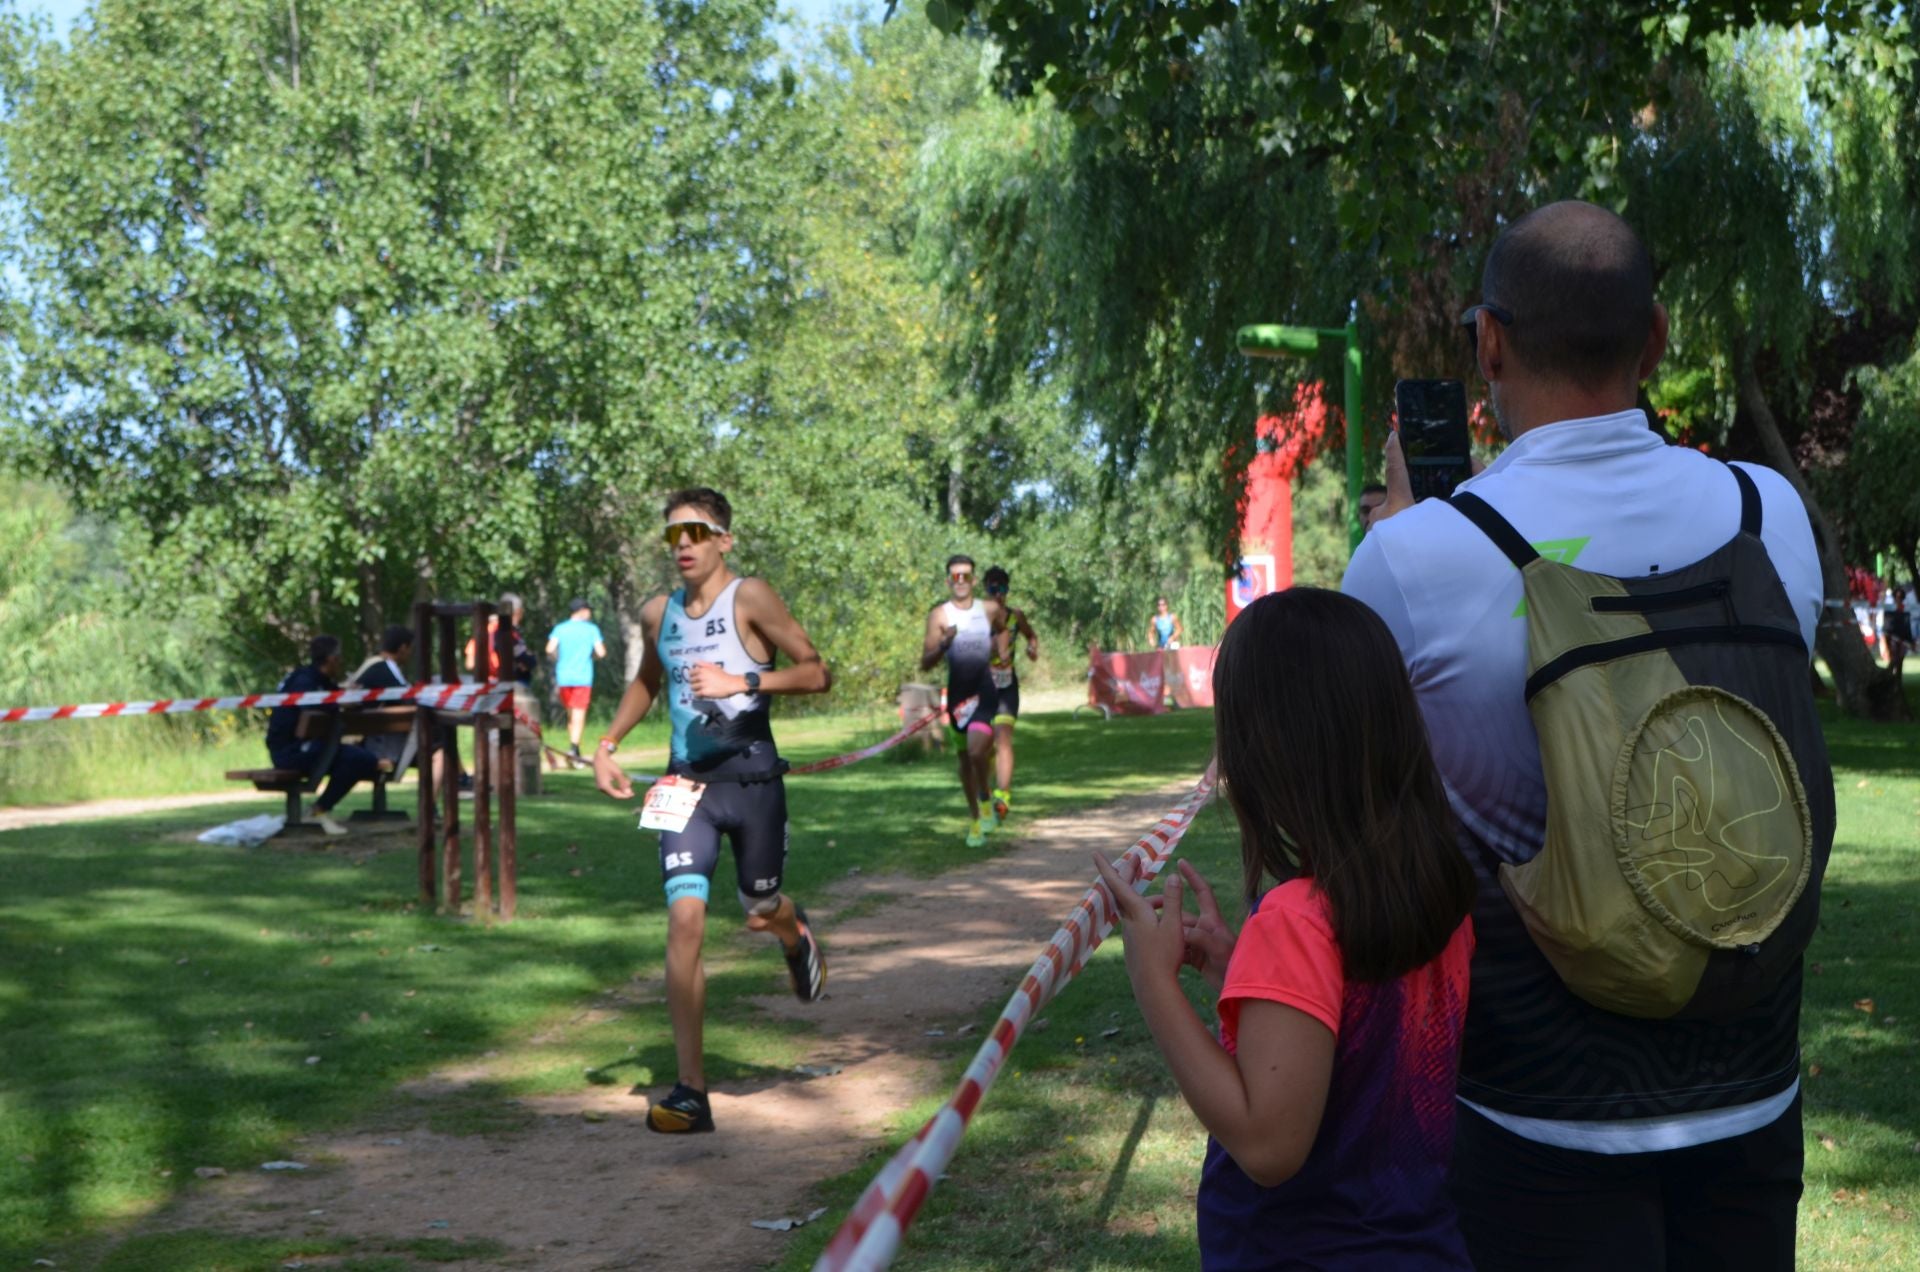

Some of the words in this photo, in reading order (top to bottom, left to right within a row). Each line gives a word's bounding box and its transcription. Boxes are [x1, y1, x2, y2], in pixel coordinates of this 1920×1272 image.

[705, 617, 726, 638] BS
[665, 851, 693, 871] BS
[754, 876, 778, 892] BS
